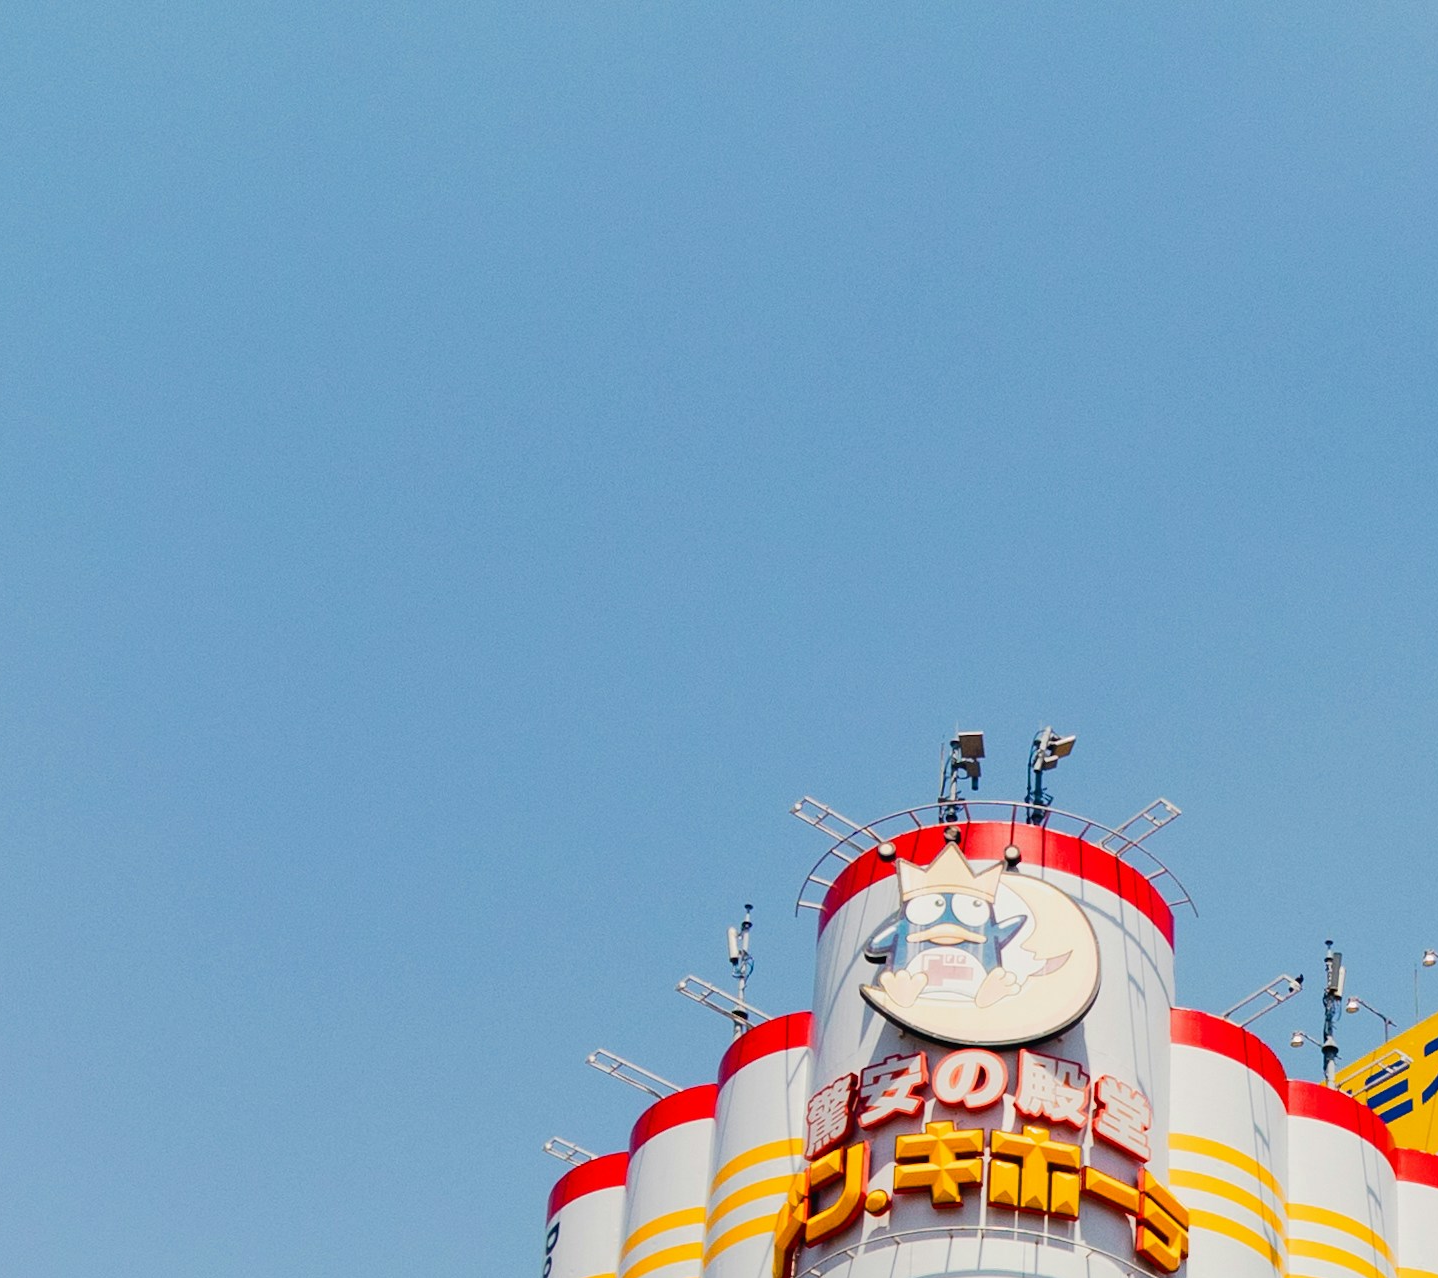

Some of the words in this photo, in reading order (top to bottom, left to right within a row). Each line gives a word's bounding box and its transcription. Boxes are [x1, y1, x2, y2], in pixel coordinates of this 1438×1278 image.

[806, 1048, 1154, 1164] 驚安の殿堂
